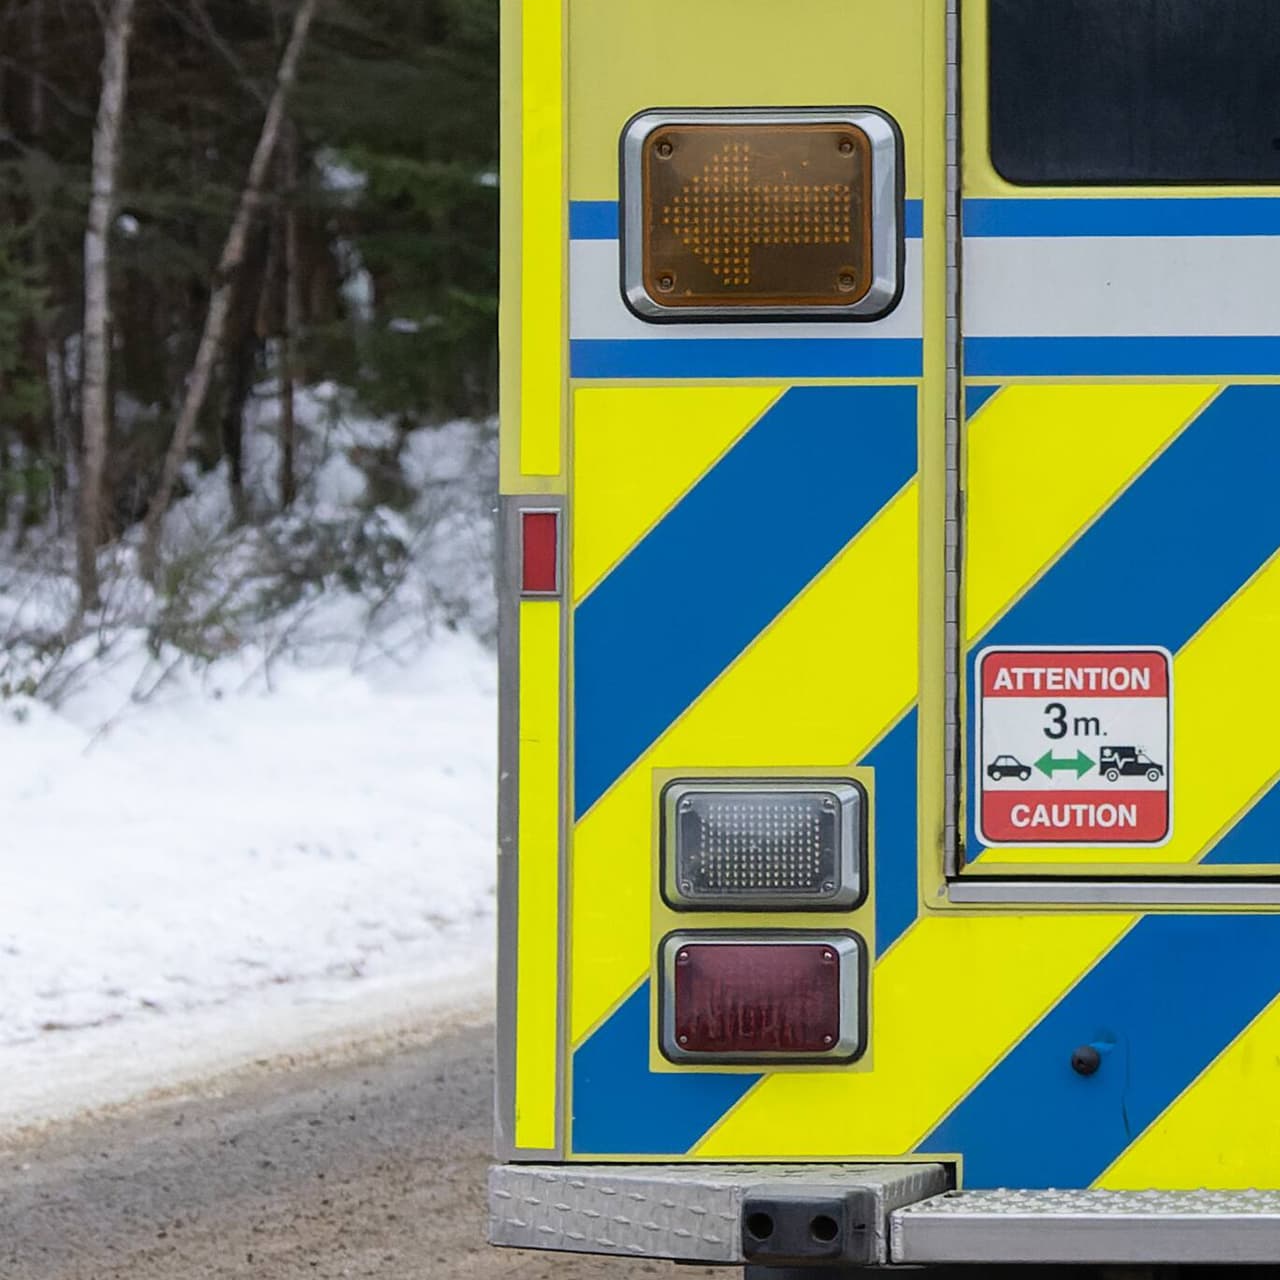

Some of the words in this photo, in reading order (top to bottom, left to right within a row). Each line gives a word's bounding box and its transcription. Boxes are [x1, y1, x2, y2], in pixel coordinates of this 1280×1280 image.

[992, 667, 1150, 690] ATTENTION
[1043, 702, 1068, 739] 3
[1073, 716, 1107, 736] m.
[1010, 803, 1137, 827] CAUTION
